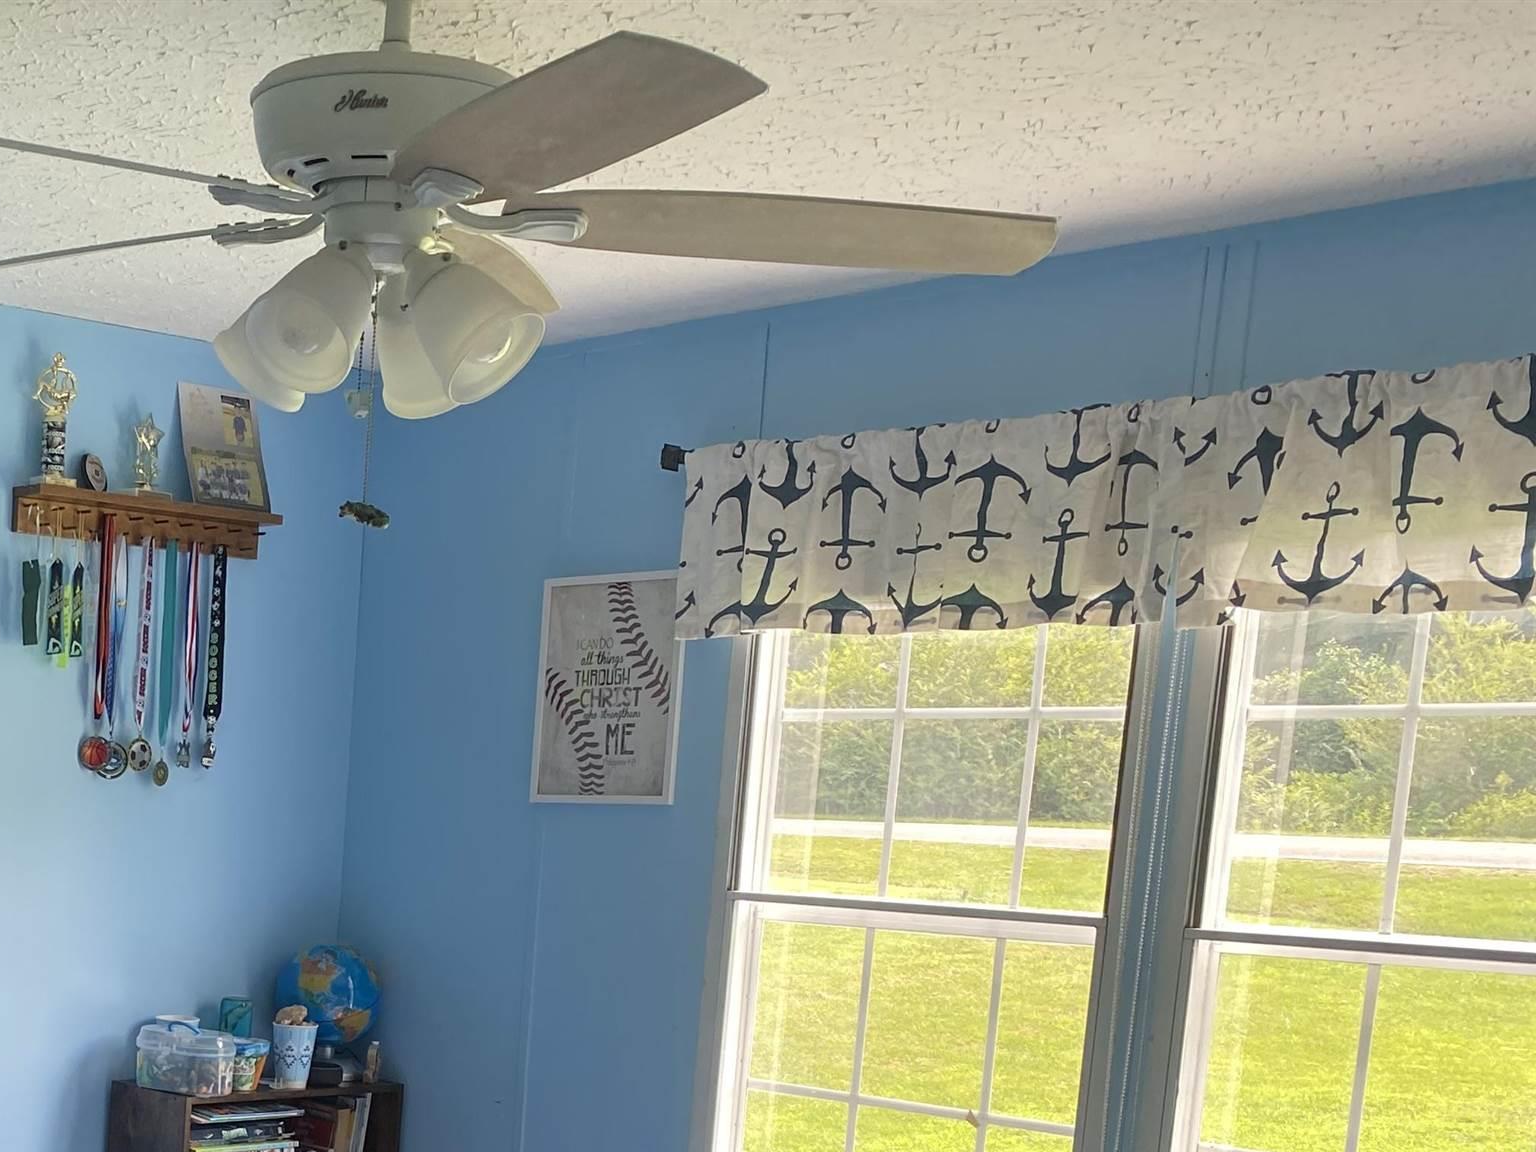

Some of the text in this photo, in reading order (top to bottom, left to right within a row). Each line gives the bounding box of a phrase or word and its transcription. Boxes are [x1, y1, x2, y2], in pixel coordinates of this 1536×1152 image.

[334, 89, 388, 112] Hunter
[599, 635, 614, 650] DO
[207, 632, 219, 705] SOCCER
[580, 651, 624, 668] all things
[574, 668, 631, 687] THROUGH
[580, 687, 642, 708] CHRIST
[605, 723, 636, 756] ME
